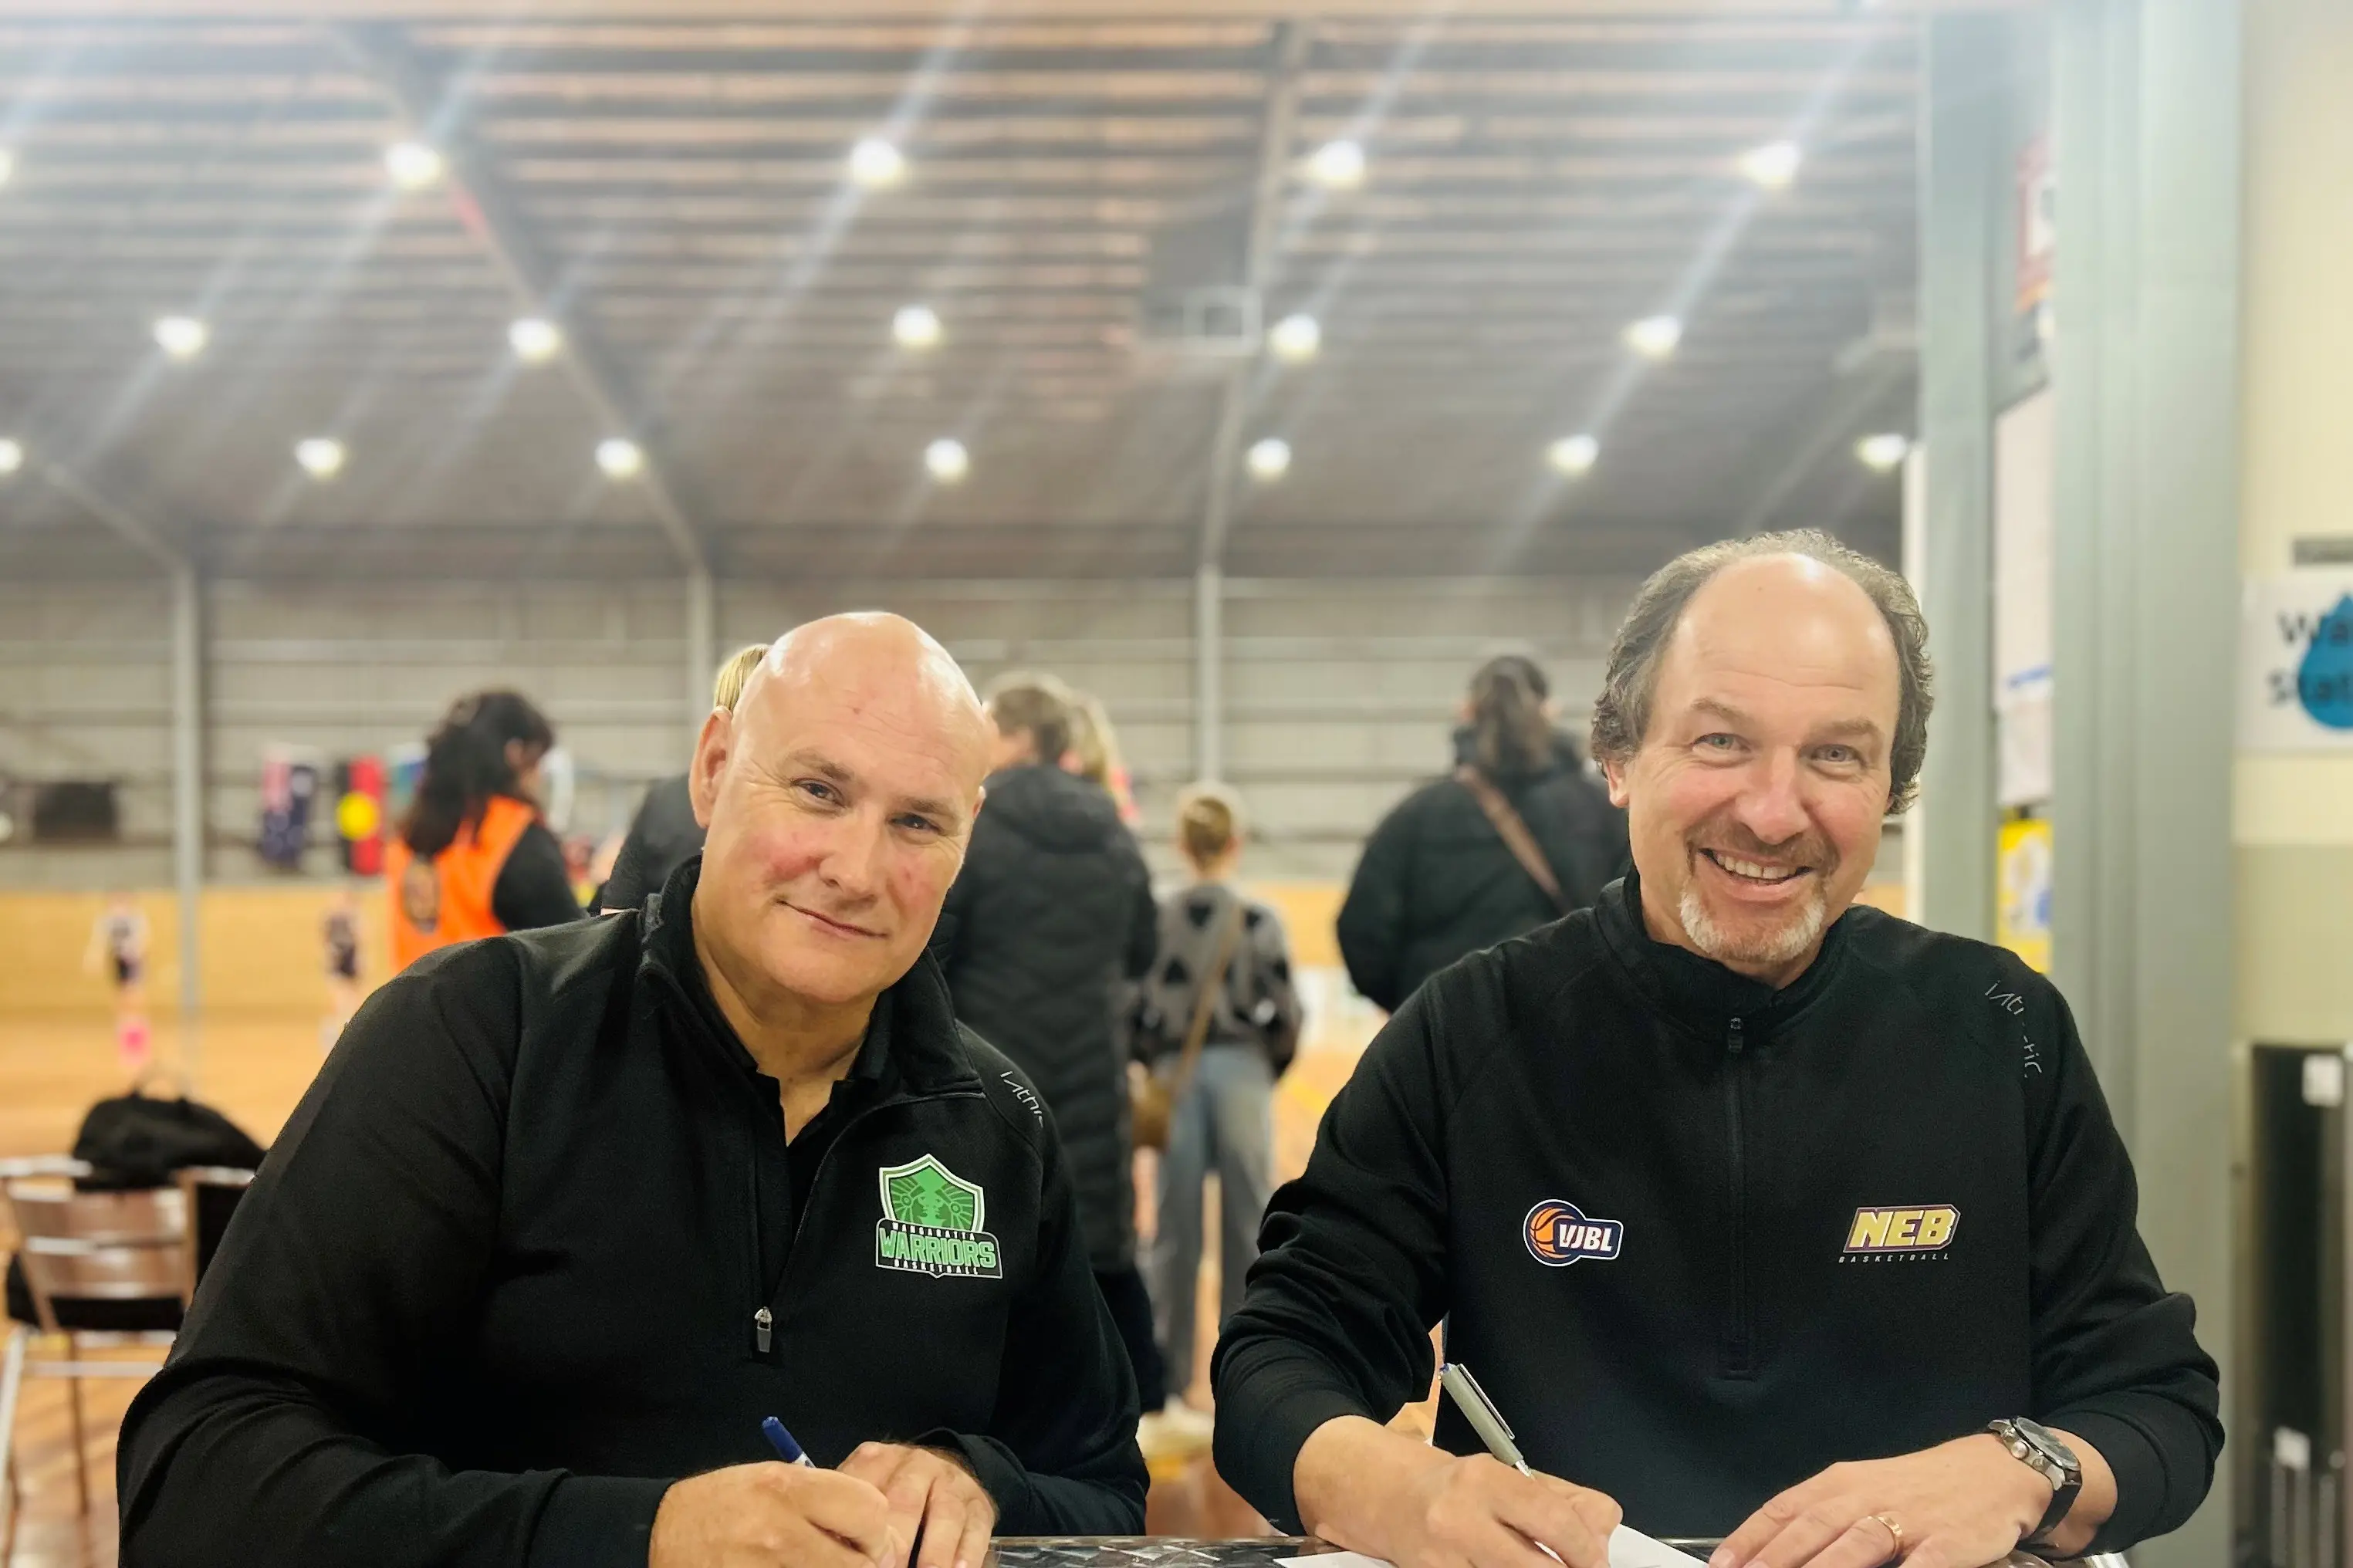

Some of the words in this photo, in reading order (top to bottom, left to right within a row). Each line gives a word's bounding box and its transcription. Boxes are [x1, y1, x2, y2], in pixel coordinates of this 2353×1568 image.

[1559, 1224, 1614, 1252] VJBL
[1848, 1208, 1956, 1248] NEB
[879, 1227, 996, 1268] WARRIORS
[1838, 1253, 1949, 1264] BASKETBALL
[894, 1259, 978, 1275] BASKETBALL
